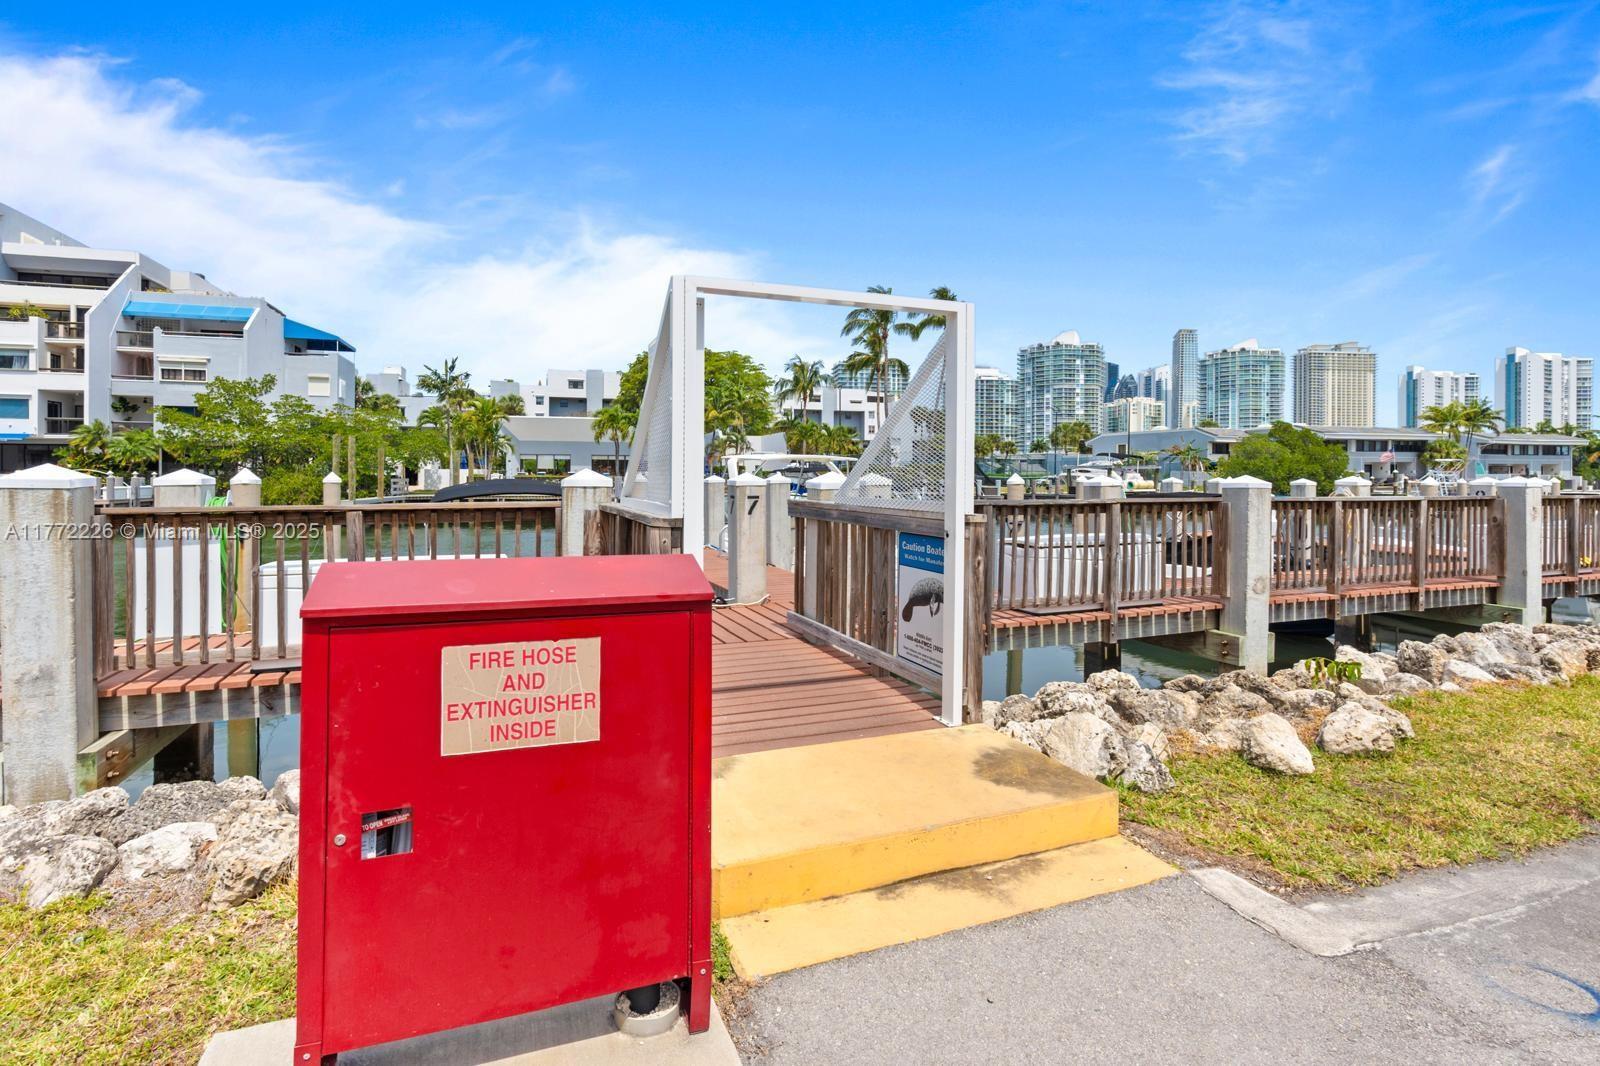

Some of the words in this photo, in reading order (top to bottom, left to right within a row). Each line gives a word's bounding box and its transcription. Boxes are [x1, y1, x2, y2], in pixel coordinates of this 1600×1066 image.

[747, 495, 760, 516] 7
[901, 540, 926, 553] Caution
[469, 650, 515, 670] FIRE
[522, 646, 577, 666] HOSE
[502, 672, 545, 692] AND
[447, 692, 596, 722] EXTINGUISHER
[490, 719, 556, 742] INSIDE
[362, 823, 370, 832] TO
[369, 819, 384, 830] OPEN
